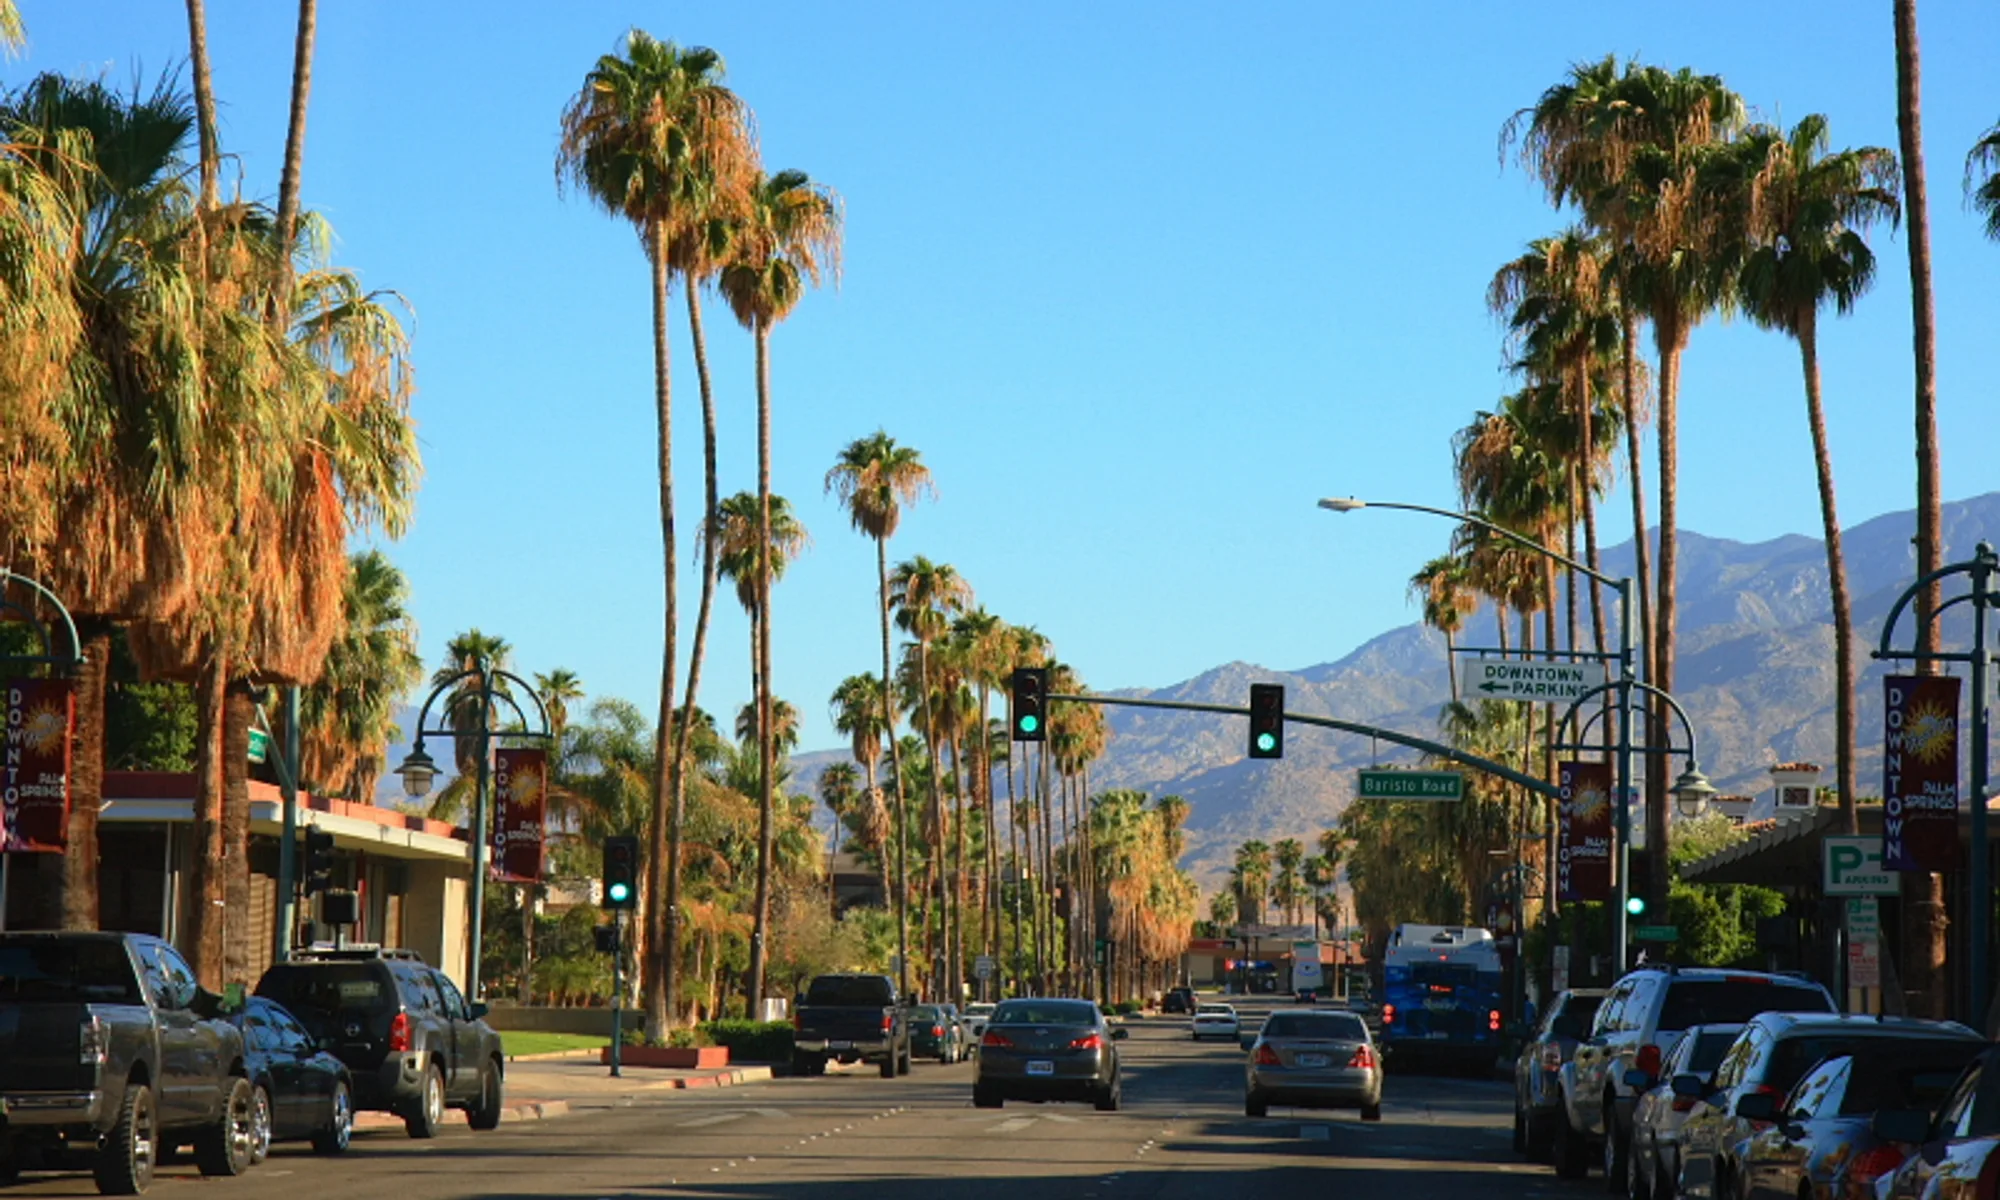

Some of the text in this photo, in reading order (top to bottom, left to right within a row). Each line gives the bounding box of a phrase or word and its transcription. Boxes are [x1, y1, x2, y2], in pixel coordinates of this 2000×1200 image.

[1485, 665, 1583, 682] DOWNTOWN
[1512, 682, 1589, 697] PARKING
[1885, 688, 1903, 860] DOWNTOWN
[1364, 777, 1455, 792] Baristo Road
[1923, 781, 1956, 795] PALM
[1904, 795, 1955, 809] SPRINGS
[495, 757, 508, 876] DOWNTOWN
[1559, 770, 1572, 892] DOWNTOWN
